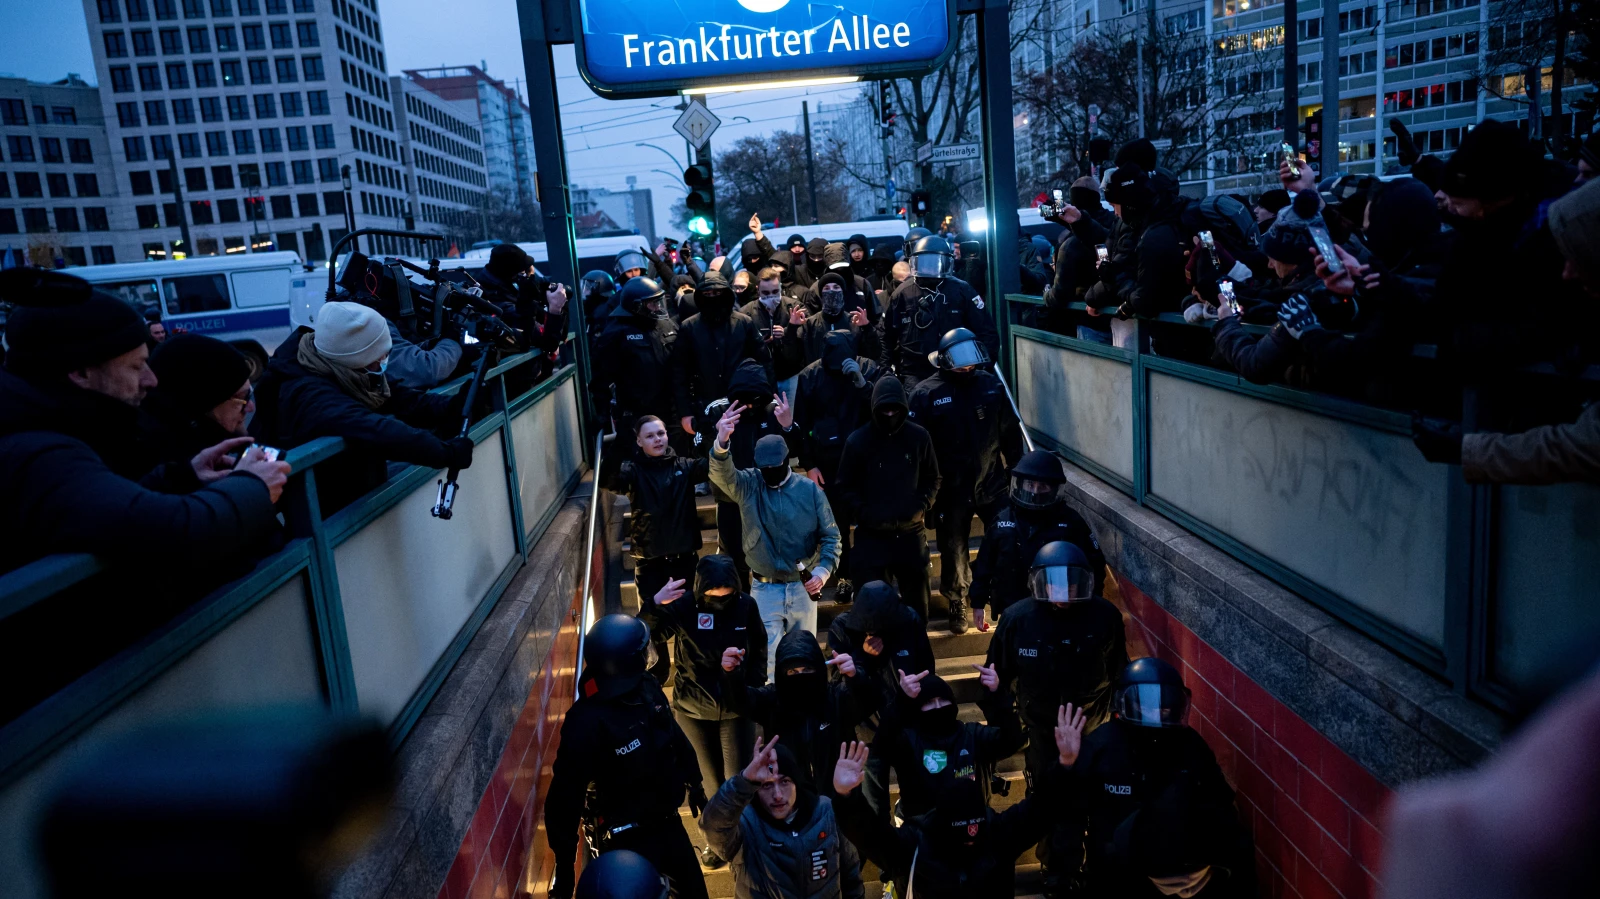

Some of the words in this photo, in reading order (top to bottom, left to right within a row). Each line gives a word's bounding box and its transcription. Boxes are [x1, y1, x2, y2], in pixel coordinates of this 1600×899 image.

[624, 26, 815, 68] Frankfurter
[827, 14, 910, 53] Allee
[175, 317, 226, 331] POLIZEI
[933, 396, 952, 406] POLIZEI
[1018, 648, 1038, 657] POLIZEI
[614, 738, 642, 756] POLIZEI
[1104, 783, 1132, 795] POLIZEI
